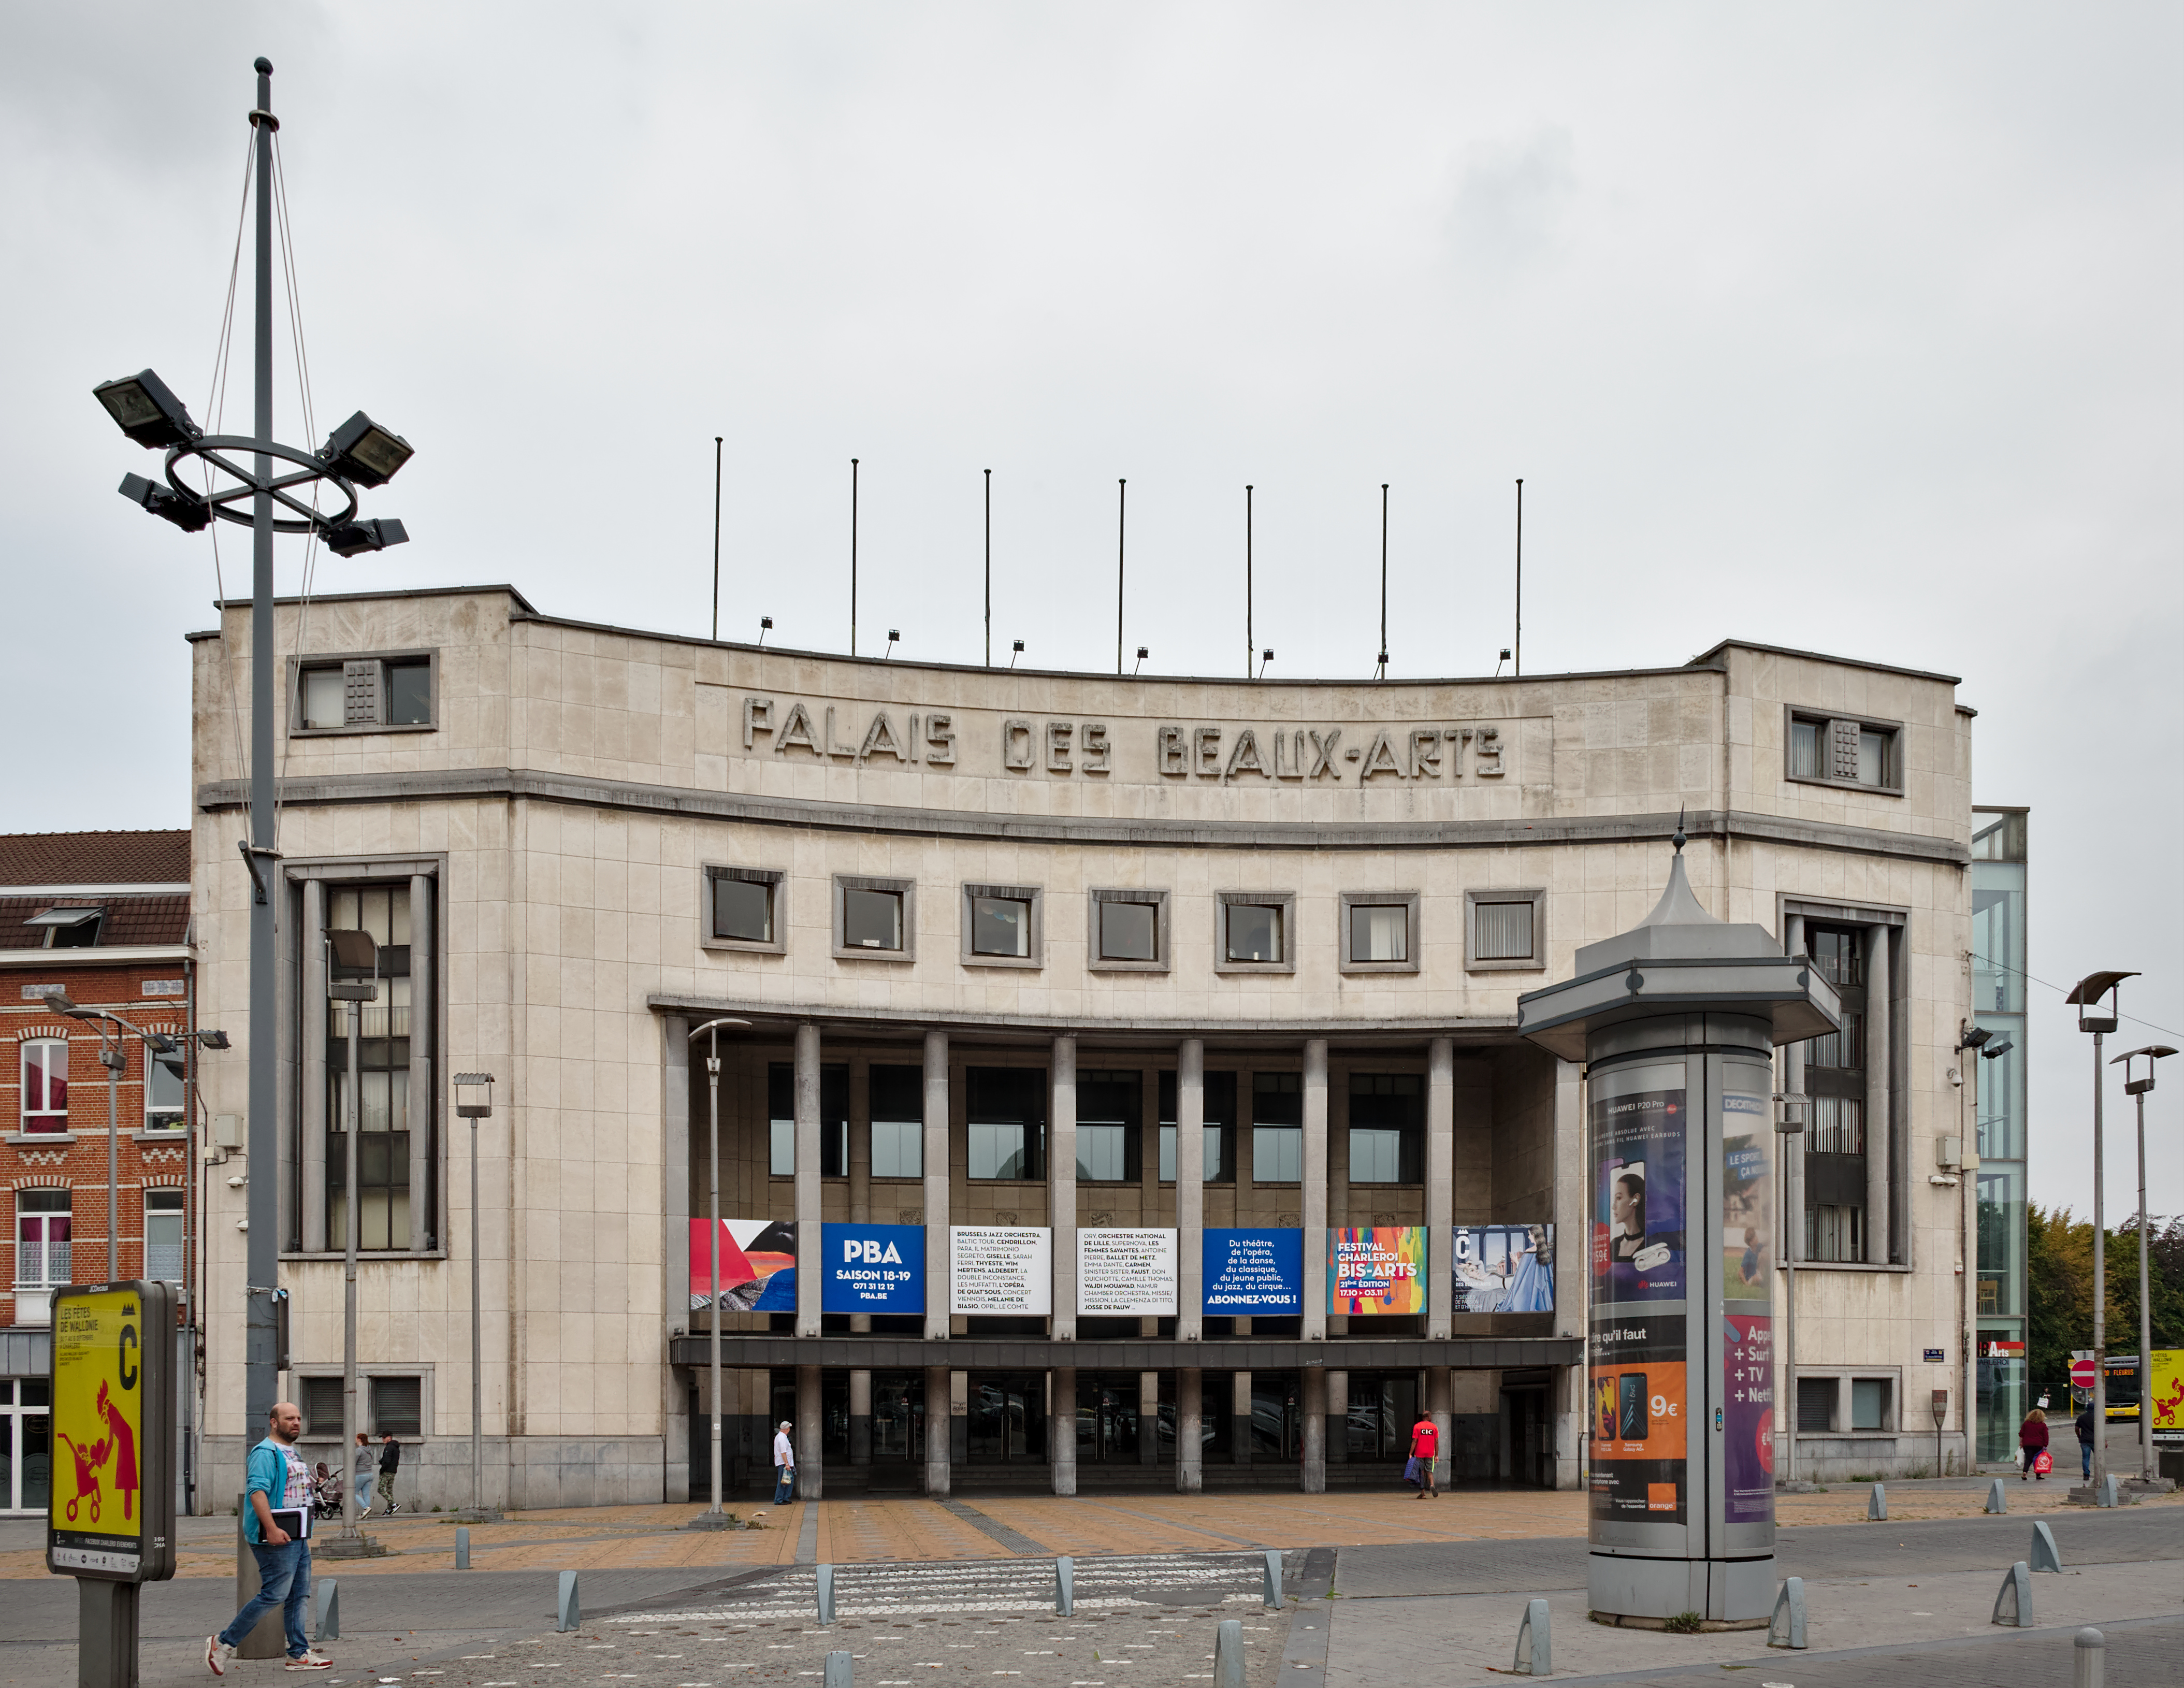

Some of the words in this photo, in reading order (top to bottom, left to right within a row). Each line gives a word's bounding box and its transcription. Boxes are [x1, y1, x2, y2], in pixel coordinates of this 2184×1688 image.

[743, 697, 956, 766] PALAIS
[1004, 720, 1111, 773] DES
[1159, 726, 1506, 778] BEAUX-ARTS
[1608, 1103, 1635, 1114] HUAWEI
[1614, 1128, 1637, 1136] ABSOLUE
[1730, 1155, 1739, 1165] LE
[1242, 1239, 1275, 1248] théâtre,
[1338, 1243, 1385, 1252] FESTIVAL
[844, 1239, 903, 1264] PBA
[1243, 1248, 1272, 1257] l'opéra,
[1338, 1252, 1398, 1262] CHARLEROI
[1238, 1265, 1277, 1274] classique,
[1338, 1263, 1418, 1278] BIS-ARTS
[836, 1269, 880, 1280] SAISON
[883, 1271, 911, 1281] 18-19
[1232, 1274, 1254, 1283] jeune
[1256, 1274, 1283, 1283] public,
[1224, 1283, 1243, 1292] jazz,
[1358, 1279, 1390, 1288] ÉDITION
[1207, 1295, 1291, 1304] ABONNEZ-VOUS
[61, 1308, 72, 1319] LES
[73, 1304, 91, 1318] FÊTES
[61, 1321, 68, 1332] DE
[69, 1319, 98, 1332] WALLONIE
[1602, 1330, 1621, 1344] qu'il
[1623, 1328, 1646, 1340] faut
[1748, 1367, 1764, 1381] TV
[1650, 1395, 1677, 1417] 9€
